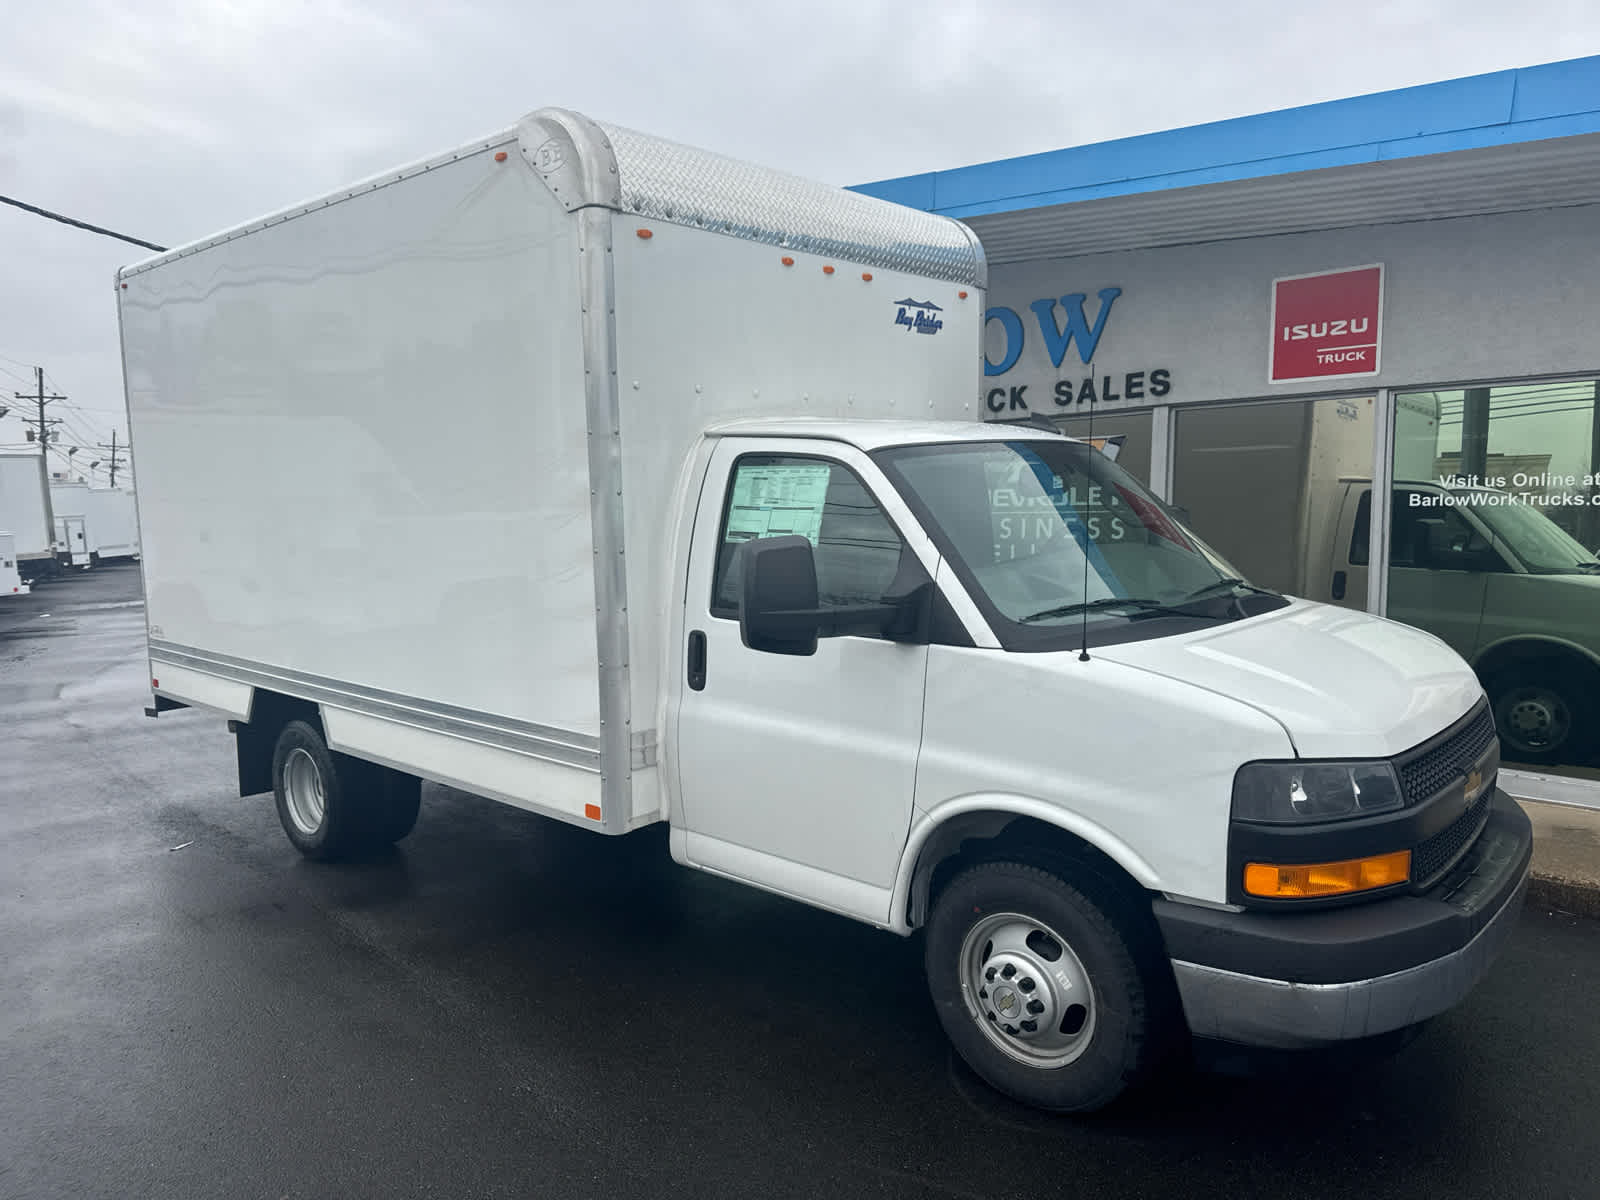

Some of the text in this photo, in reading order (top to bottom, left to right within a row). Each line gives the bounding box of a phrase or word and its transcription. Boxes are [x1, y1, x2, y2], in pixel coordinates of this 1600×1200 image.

[1283, 318, 1368, 341] ISUZU
[1316, 351, 1366, 364] TRUCK
[1054, 369, 1170, 406] SALES
[1440, 472, 1600, 487] Visit us Online at
